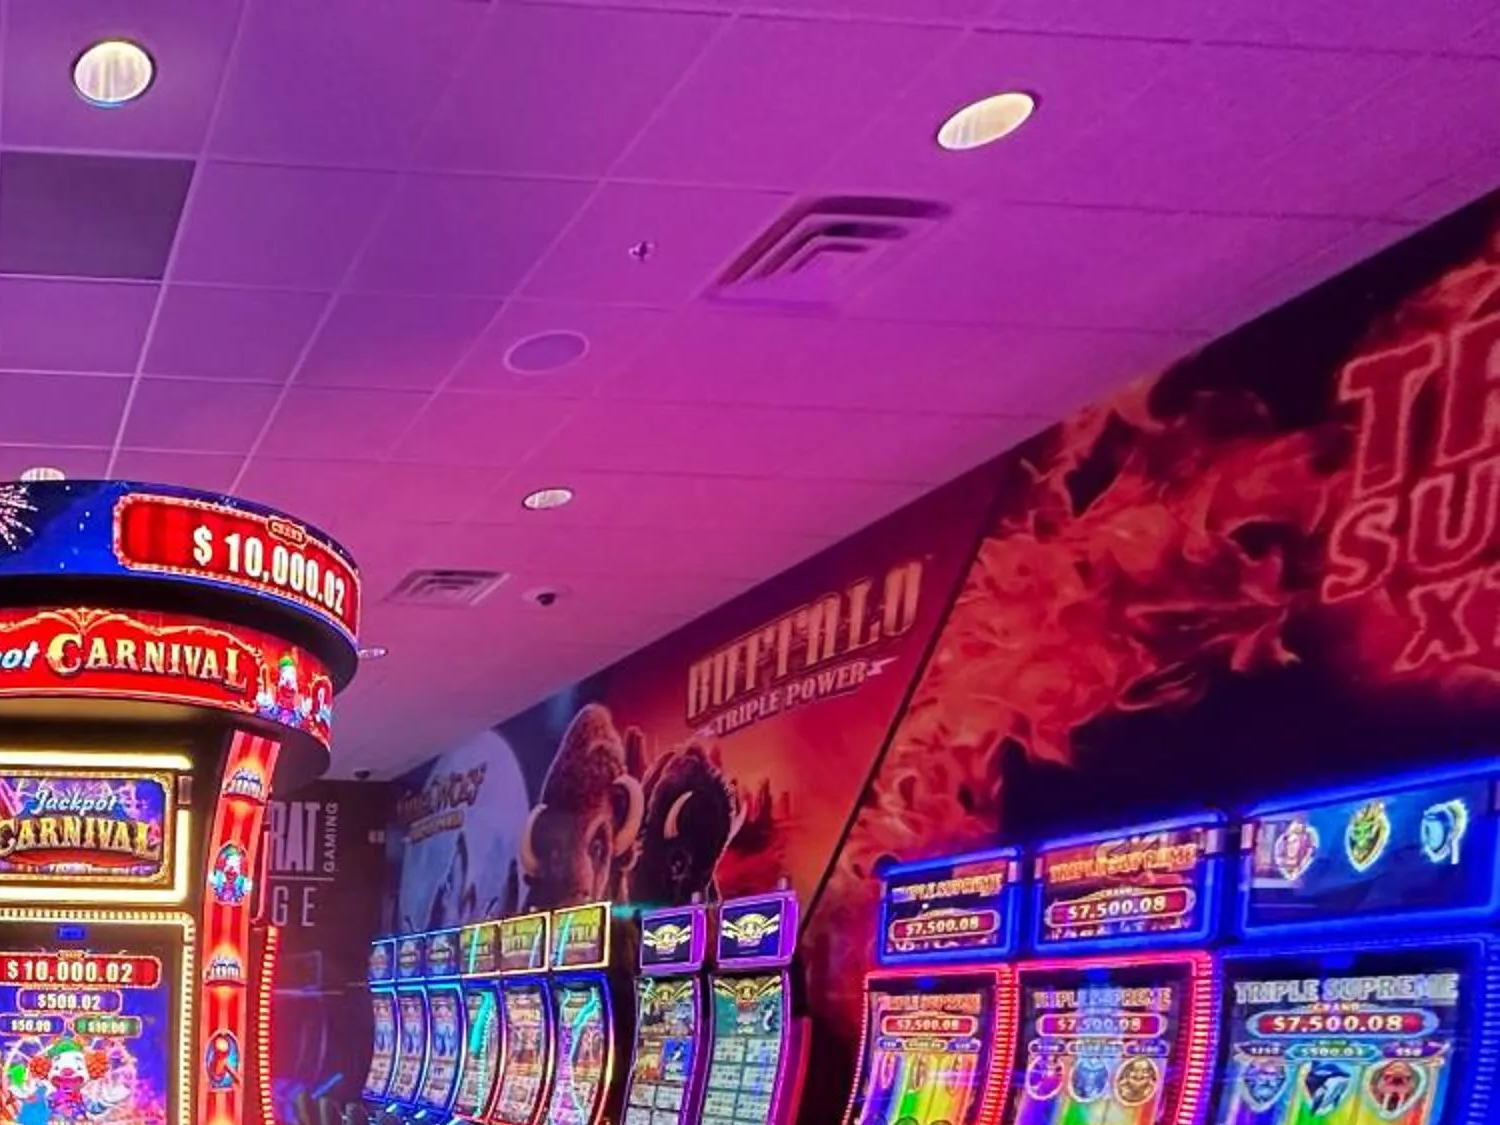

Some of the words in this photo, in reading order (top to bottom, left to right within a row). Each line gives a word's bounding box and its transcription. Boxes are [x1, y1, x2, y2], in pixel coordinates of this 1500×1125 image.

[46, 633, 248, 690] CARNIVAL
[715, 690, 780, 735] TRIPLE
[786, 660, 868, 707] POWER
[30, 781, 120, 816] Jackpot
[323, 801, 339, 874] GAMING
